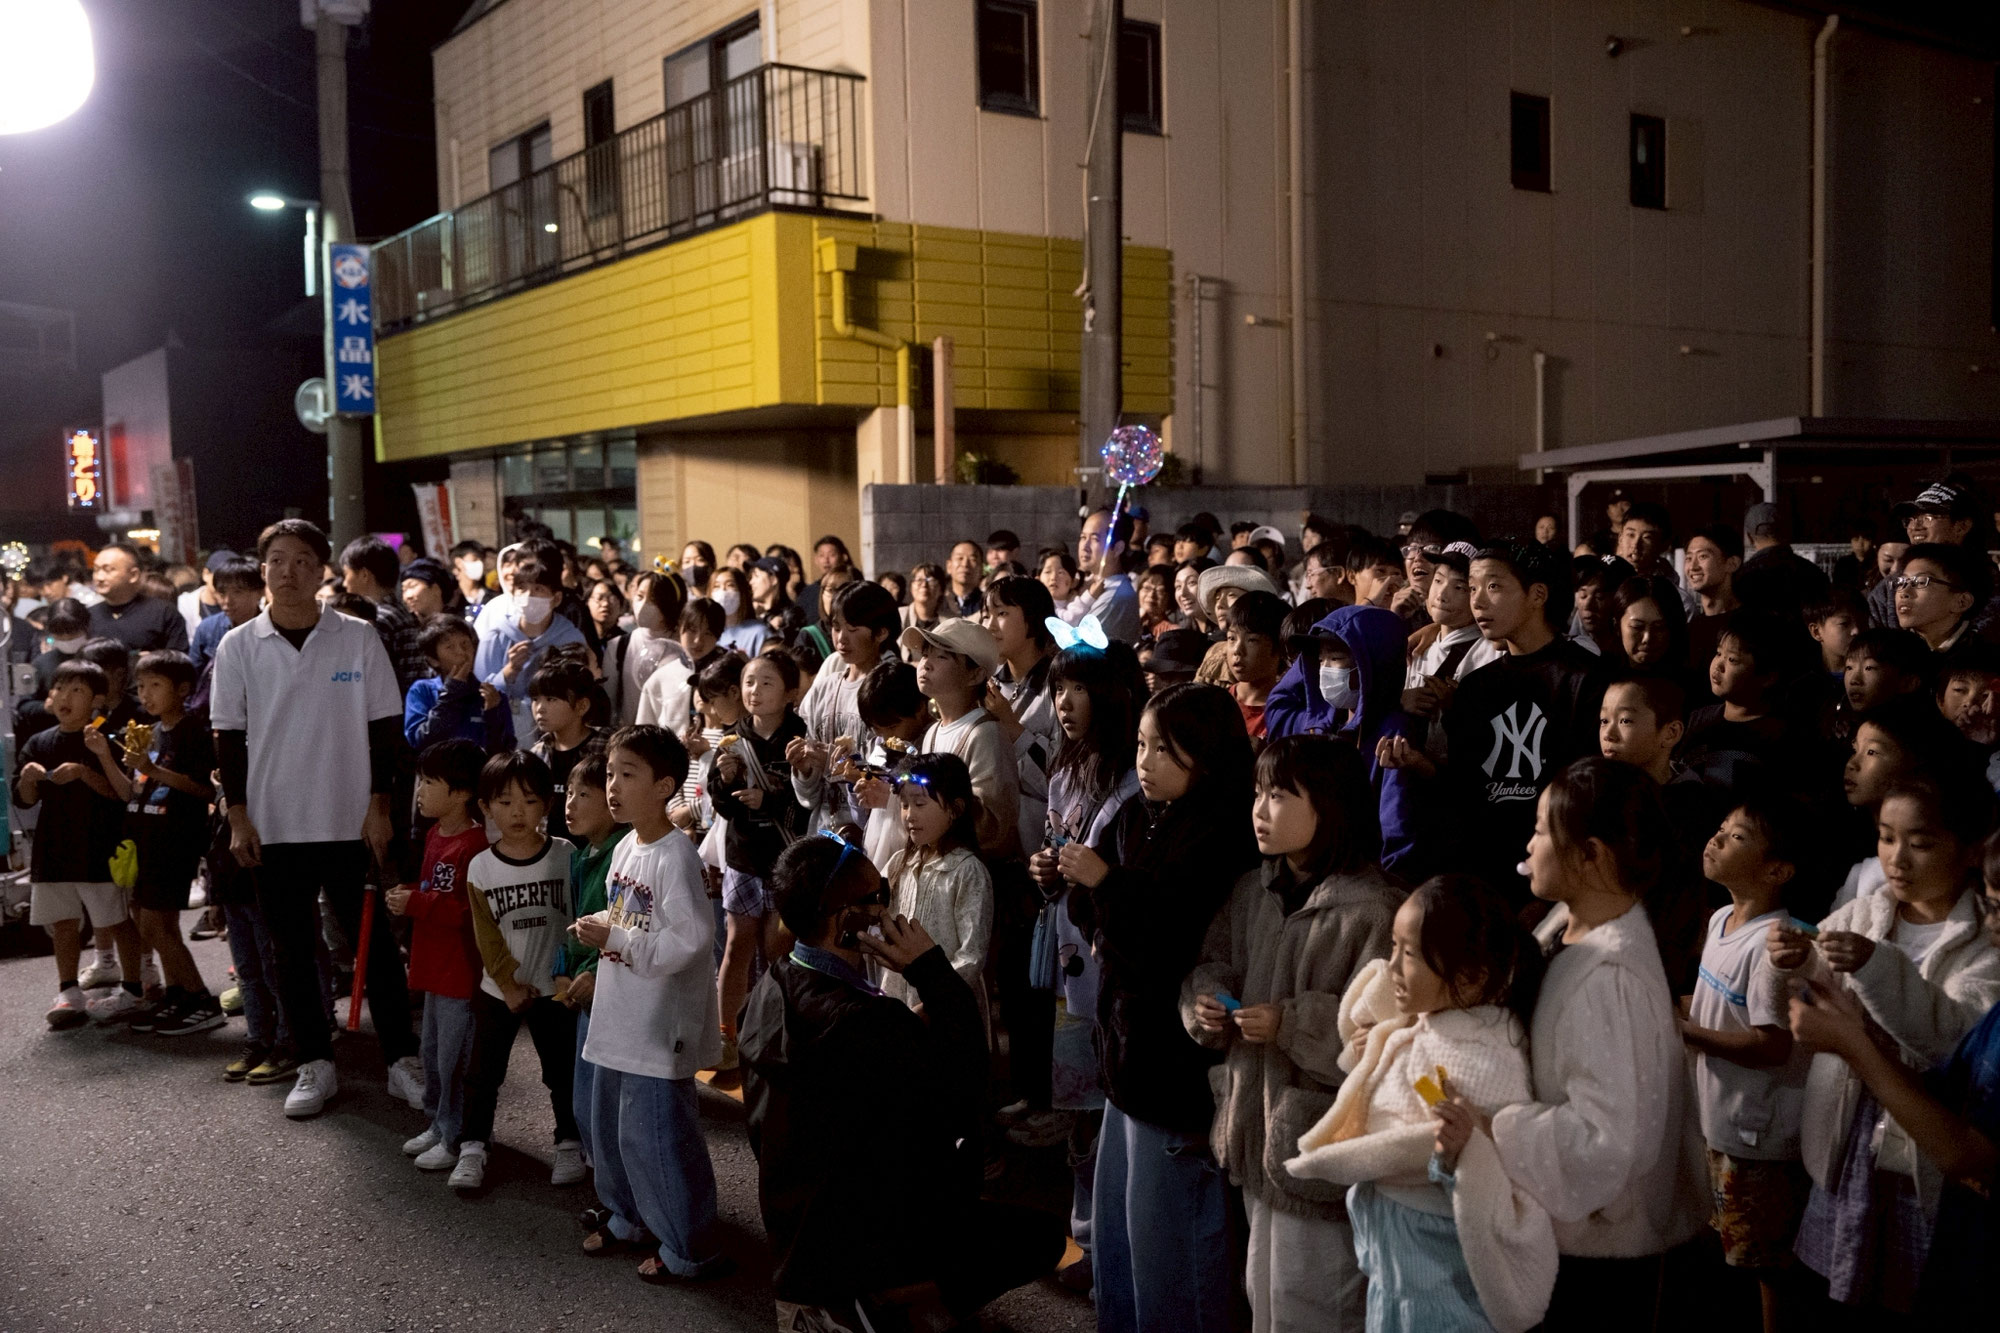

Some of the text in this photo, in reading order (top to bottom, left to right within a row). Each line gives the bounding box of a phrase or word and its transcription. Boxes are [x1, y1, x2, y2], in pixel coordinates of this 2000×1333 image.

[337, 298, 373, 401] 水晶米
[331, 671, 352, 682] JCI
[1481, 700, 1548, 781] NY
[1485, 781, 1538, 804] Yankees
[483, 879, 568, 926] CHEERFUL
[512, 916, 547, 931] MORNING
